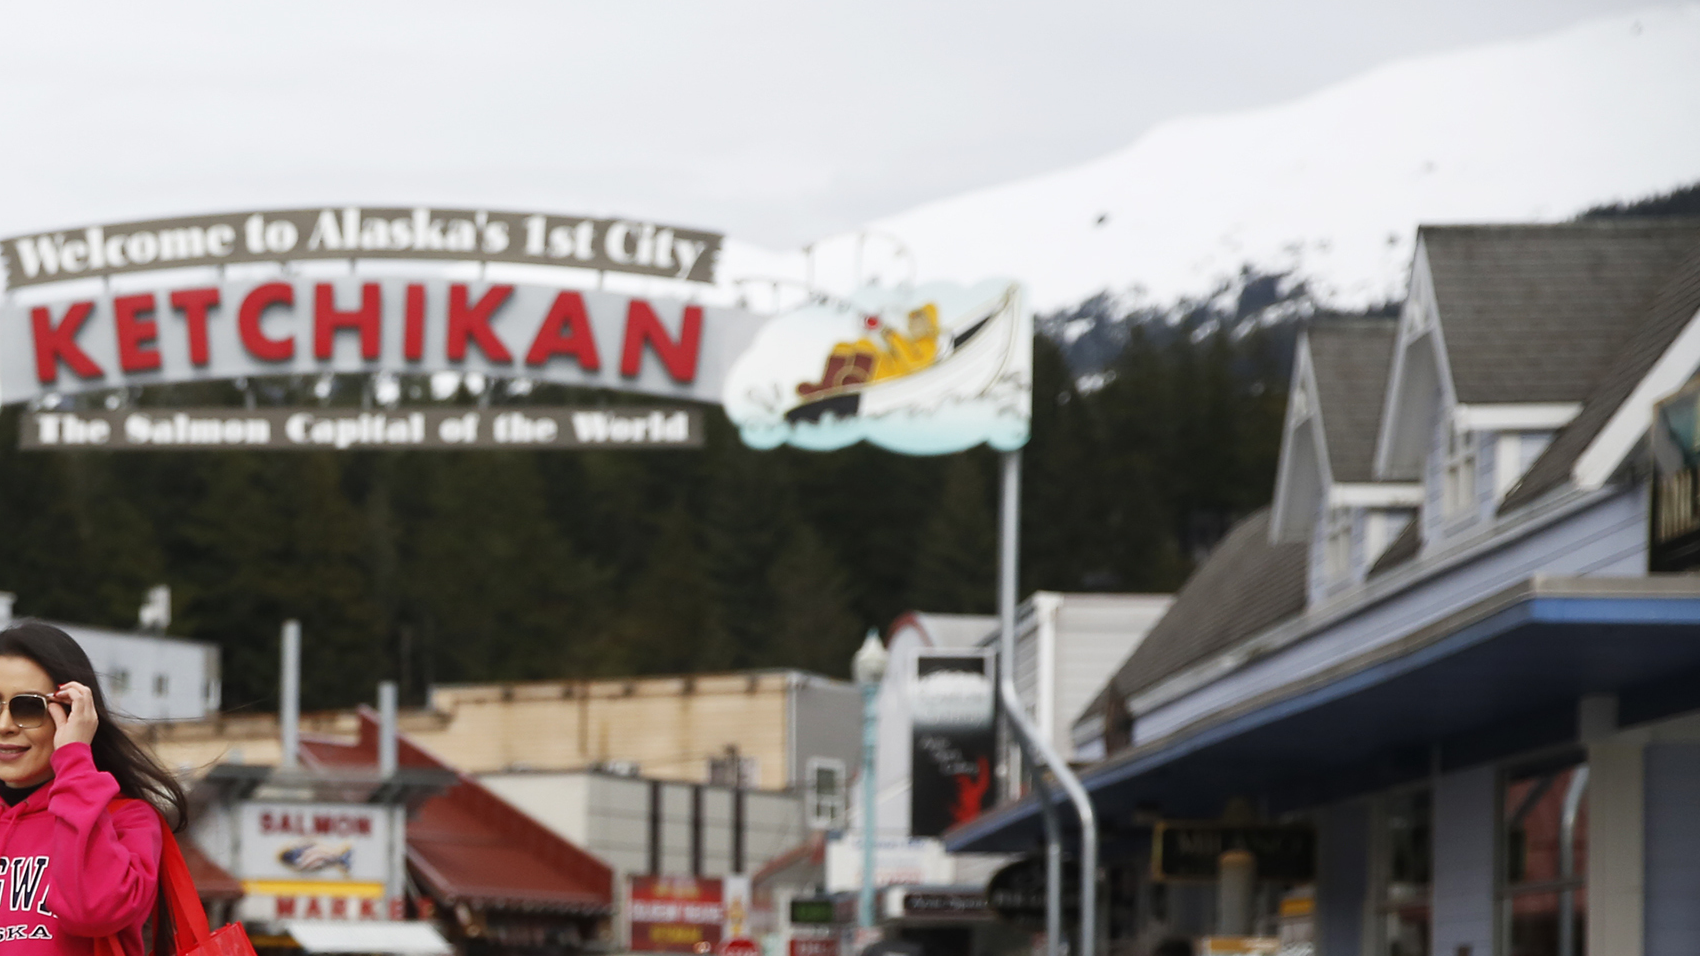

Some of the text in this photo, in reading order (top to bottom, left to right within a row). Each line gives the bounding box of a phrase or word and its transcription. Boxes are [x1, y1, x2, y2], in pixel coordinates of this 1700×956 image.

[15, 206, 706, 279] Welcome to Alaska's 1st City
[30, 281, 705, 385] KETCHIKAN
[35, 410, 690, 450] The Salmon Capital of the World
[260, 811, 373, 837] SALMON
